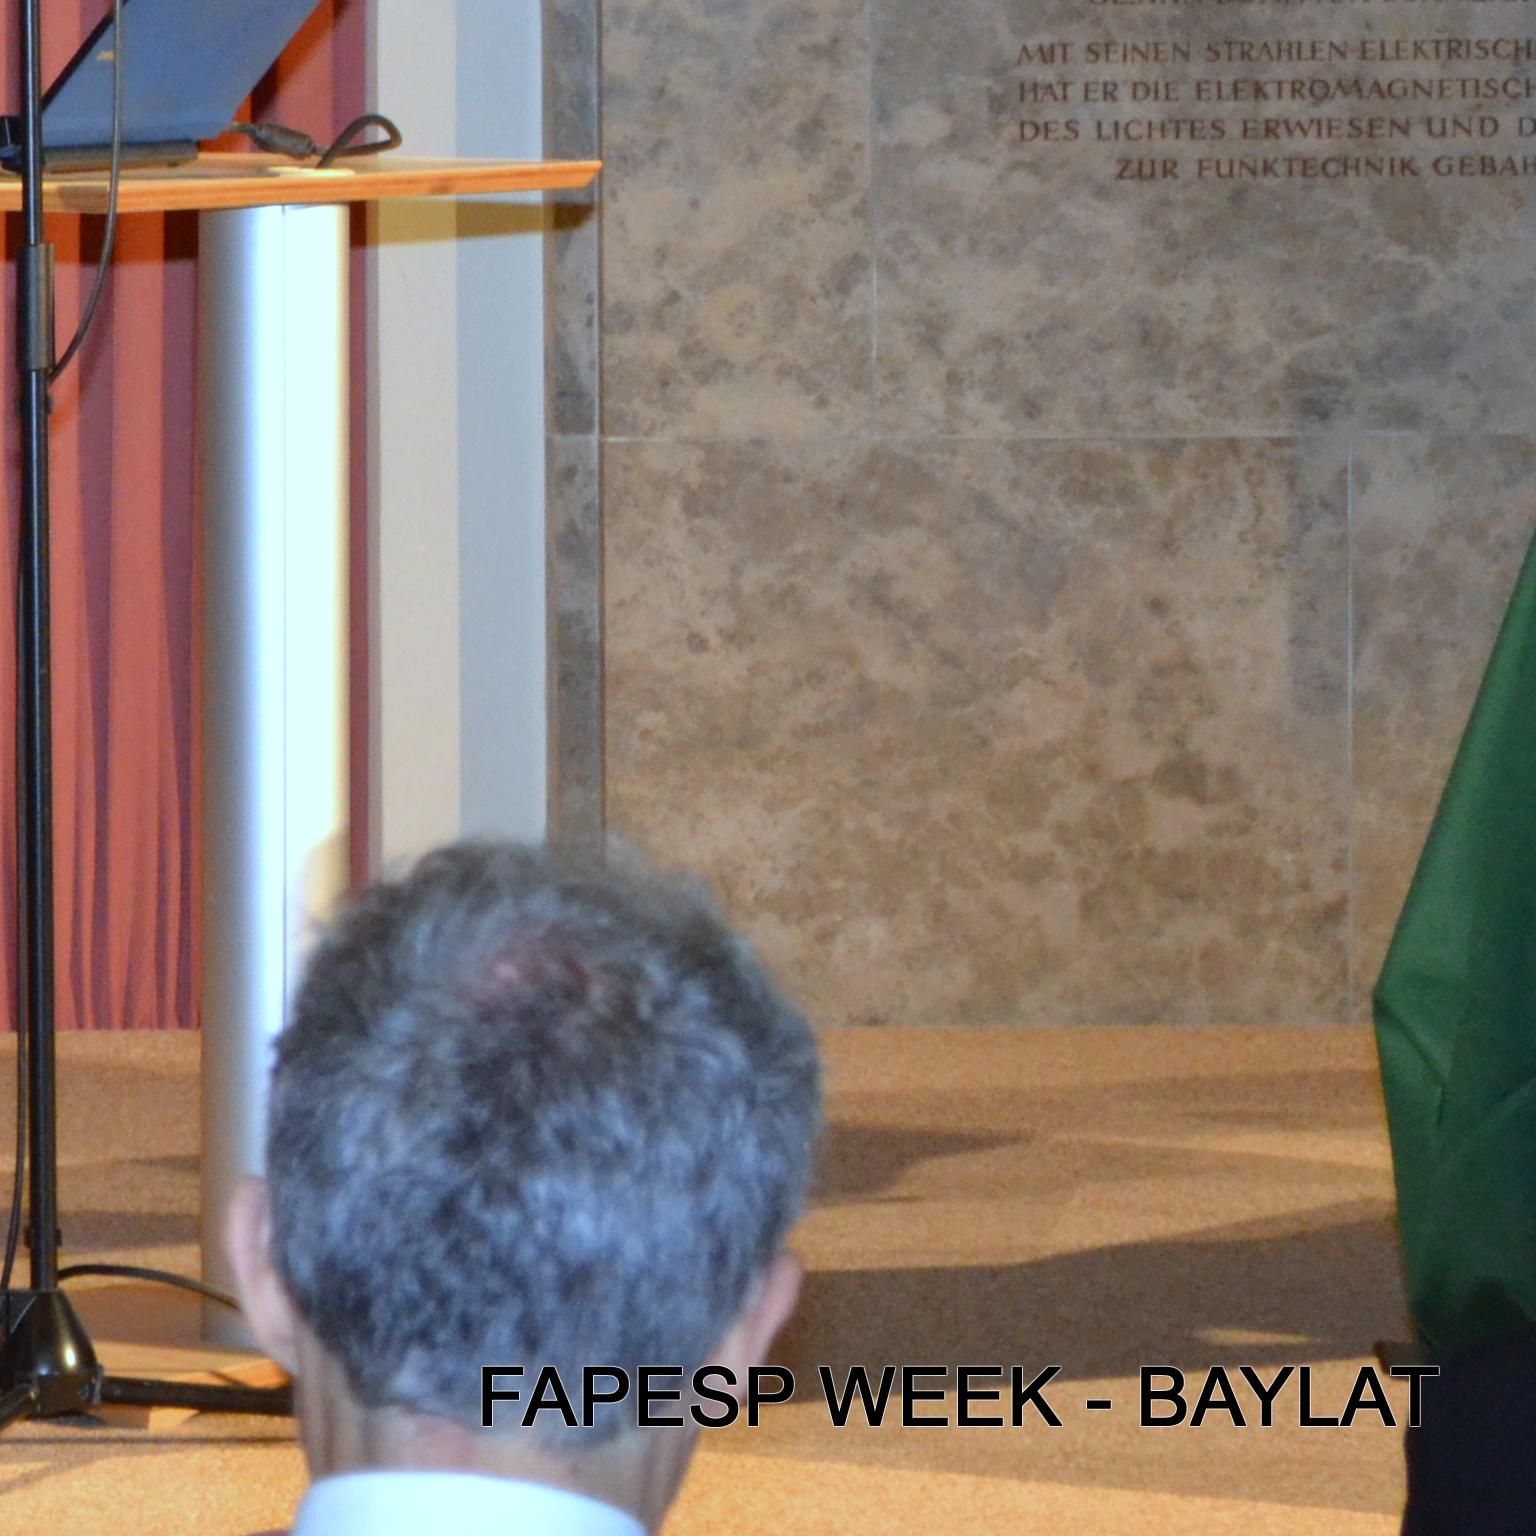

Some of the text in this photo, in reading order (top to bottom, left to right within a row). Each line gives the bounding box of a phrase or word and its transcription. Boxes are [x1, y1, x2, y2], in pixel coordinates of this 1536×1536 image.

[1017, 37, 1536, 66] MIT SEINEN STRAHLEN ELEKTRISCH
[1017, 80, 1073, 104] HAT
[1083, 80, 1118, 103] ER
[1131, 79, 1180, 103] DIE
[1018, 119, 1080, 143] DES
[1095, 118, 1226, 143] LICHTES
[1241, 116, 1412, 141] ERWIESEN
[1424, 116, 1500, 140] UND
[1115, 157, 1179, 182] ZUR
[1197, 156, 1420, 181] FUNKTECHNIK
